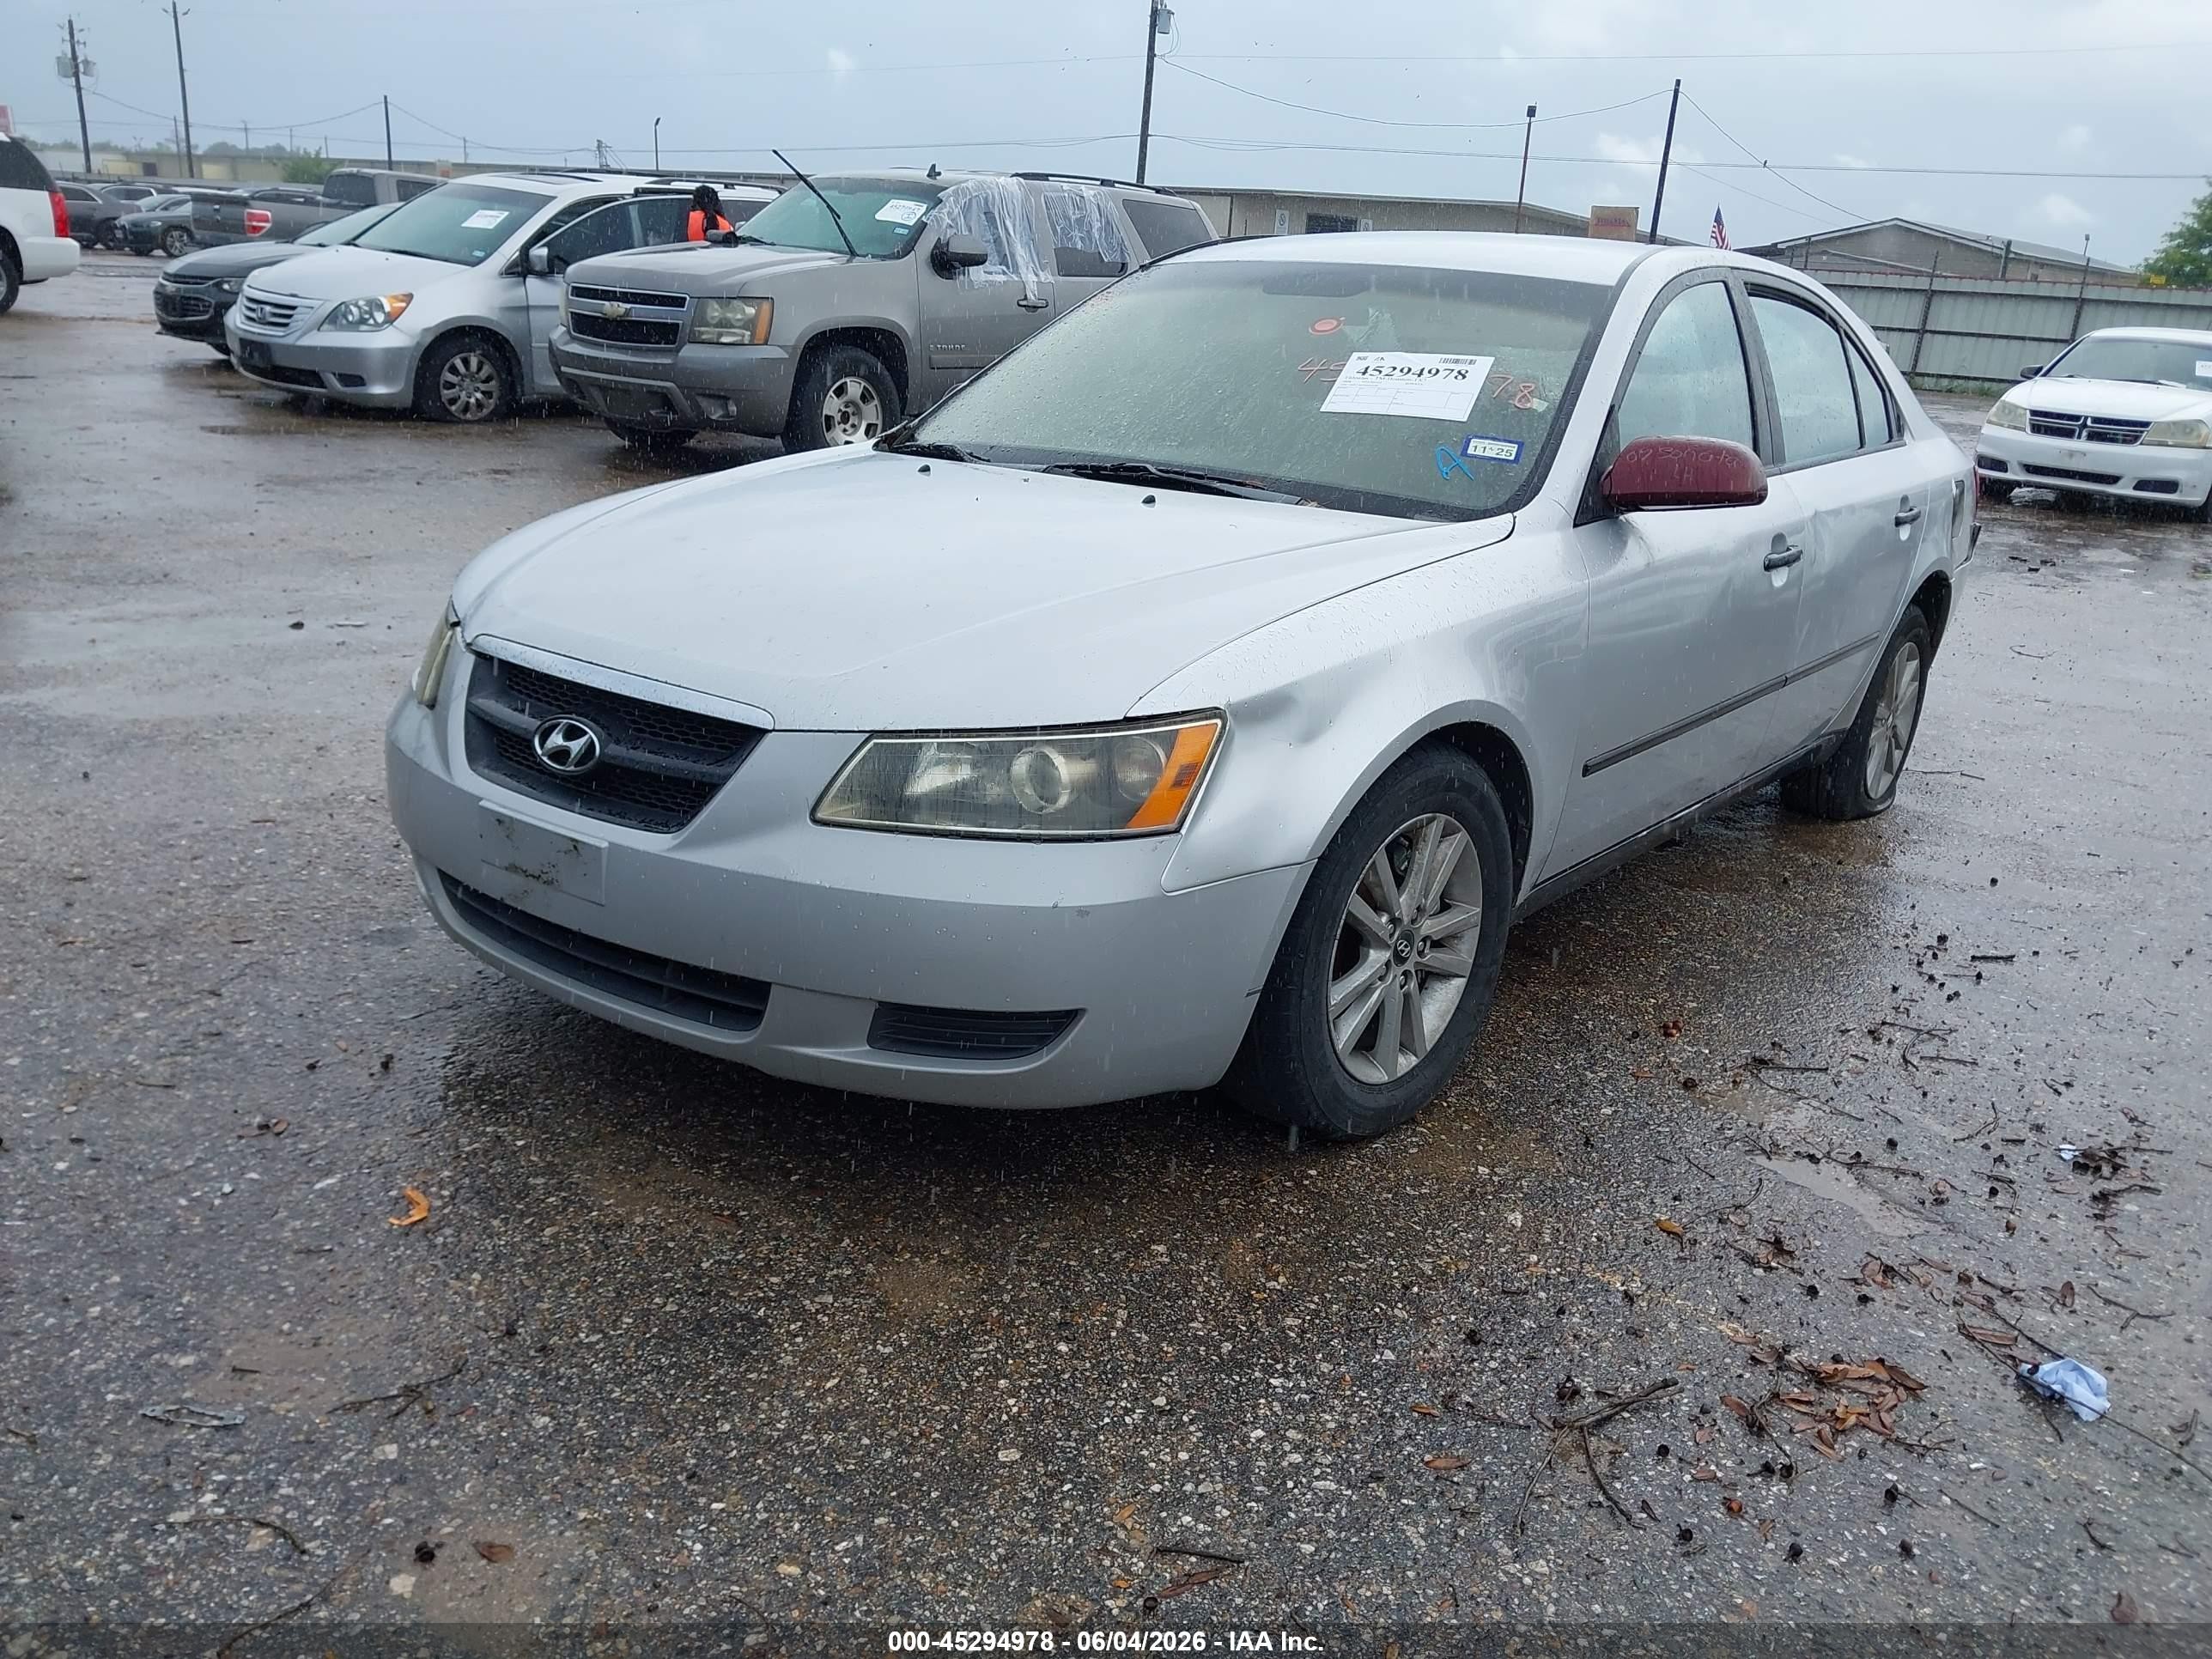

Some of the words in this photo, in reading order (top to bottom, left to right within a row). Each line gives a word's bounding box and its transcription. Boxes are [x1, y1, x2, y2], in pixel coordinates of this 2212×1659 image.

[1355, 365, 1470, 381] 45294978
[1471, 445, 1487, 454] 11
[1495, 447, 1514, 458] 25
